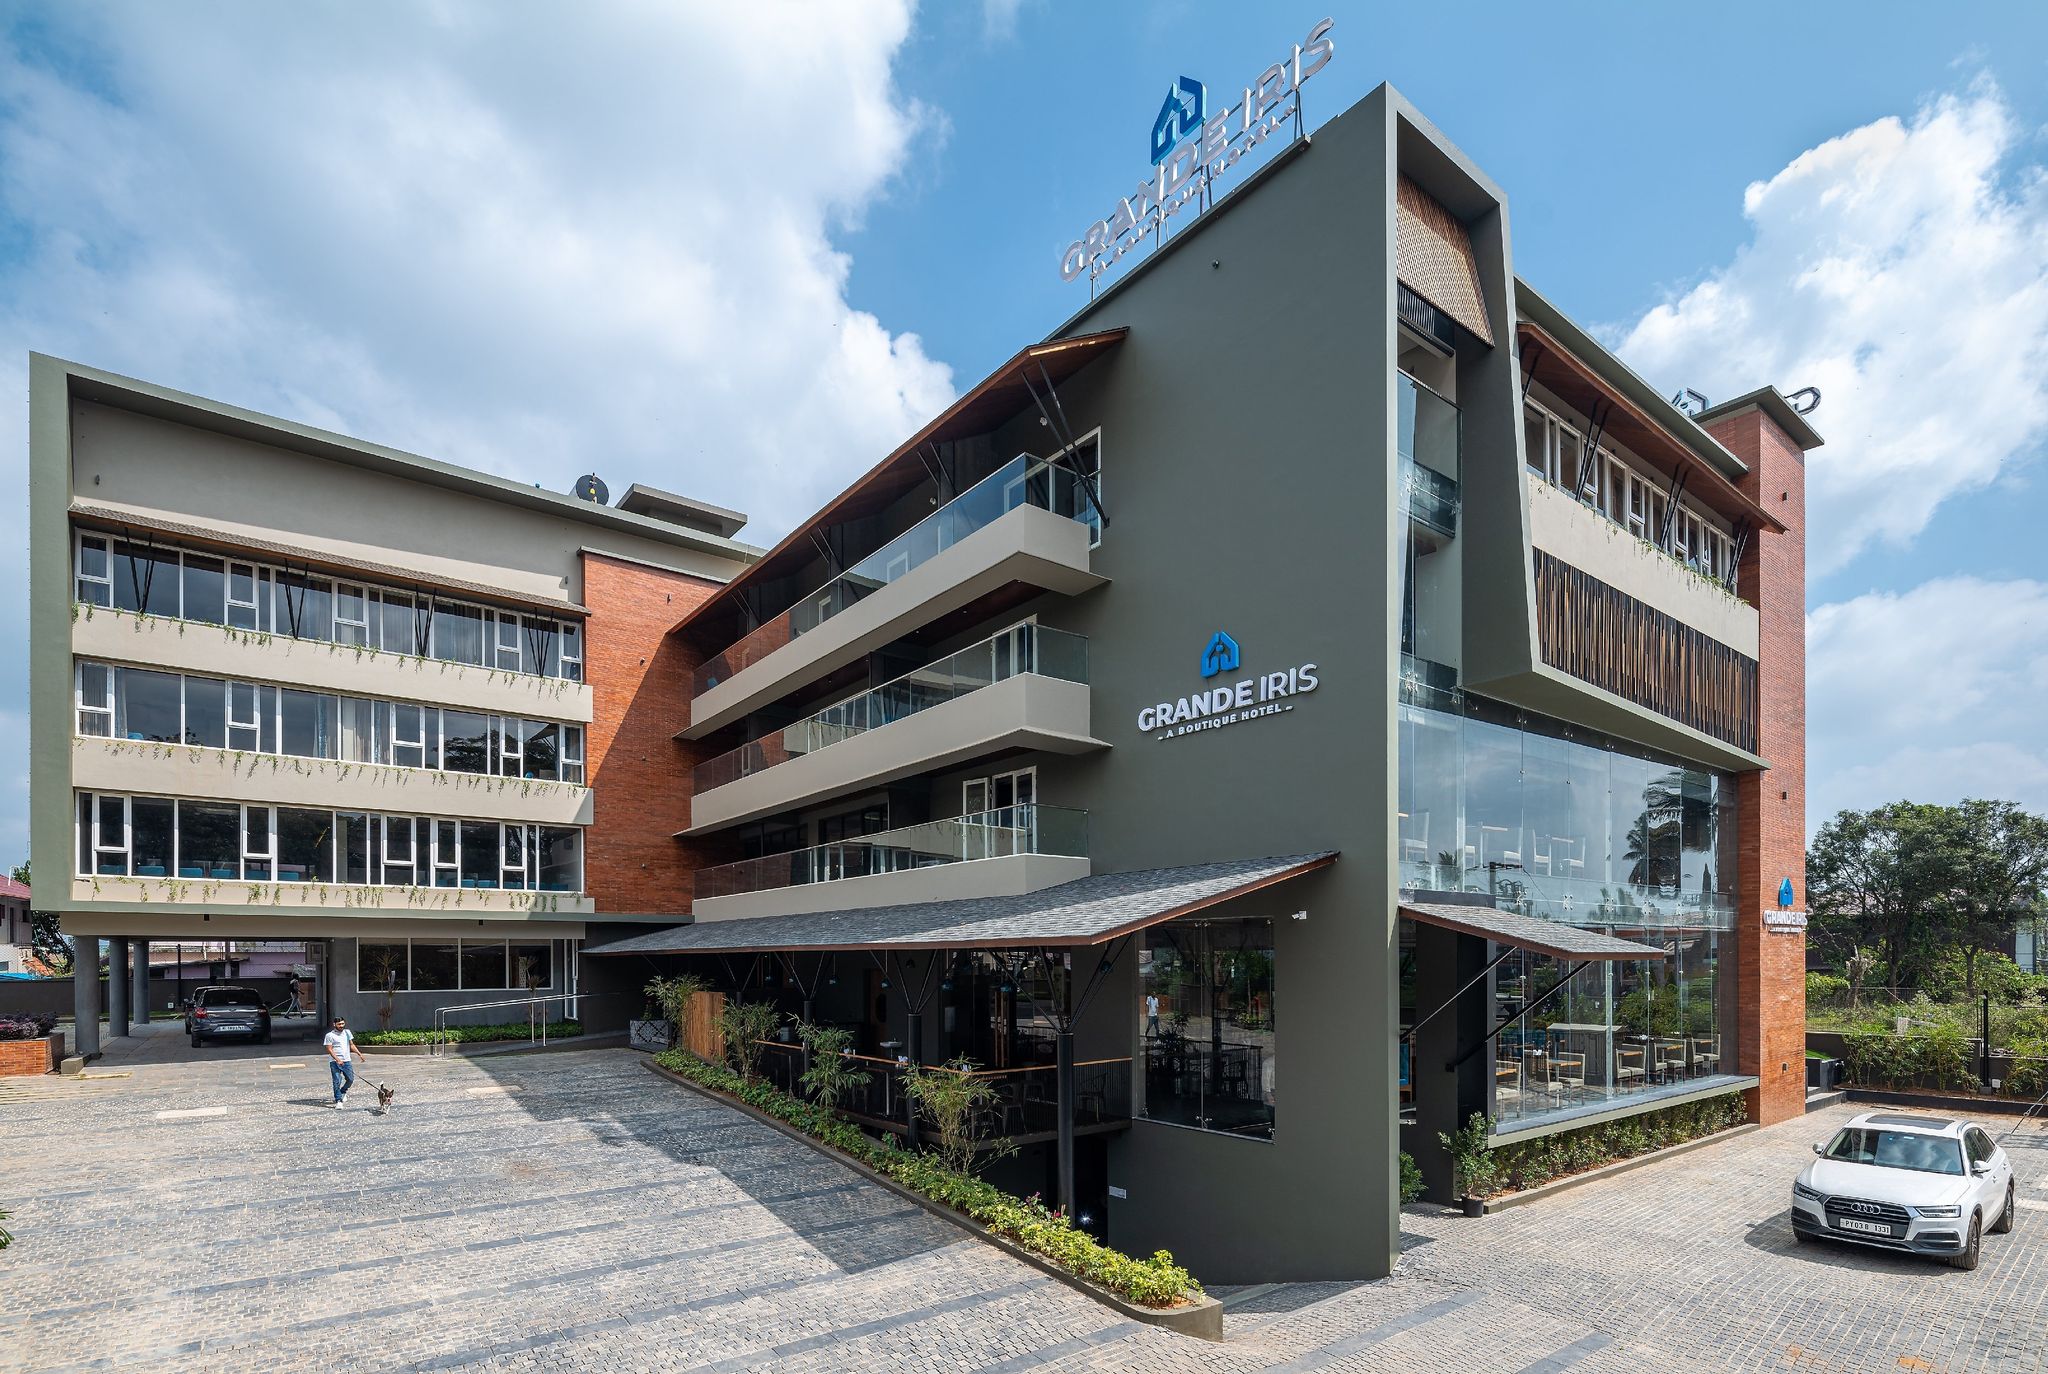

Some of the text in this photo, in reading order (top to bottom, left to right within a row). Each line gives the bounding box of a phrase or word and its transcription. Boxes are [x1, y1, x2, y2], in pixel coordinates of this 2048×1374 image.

[1060, 16, 1335, 283] GRANDE IRIS
[1212, 114, 1281, 180] HOTEL
[1137, 662, 1319, 732] GRANDE IRIS
[1166, 702, 1283, 739] A BOUTIQUE HOTEL
[1763, 909, 1796, 925] GRANDE
[1874, 1224, 1890, 1234] 1331
